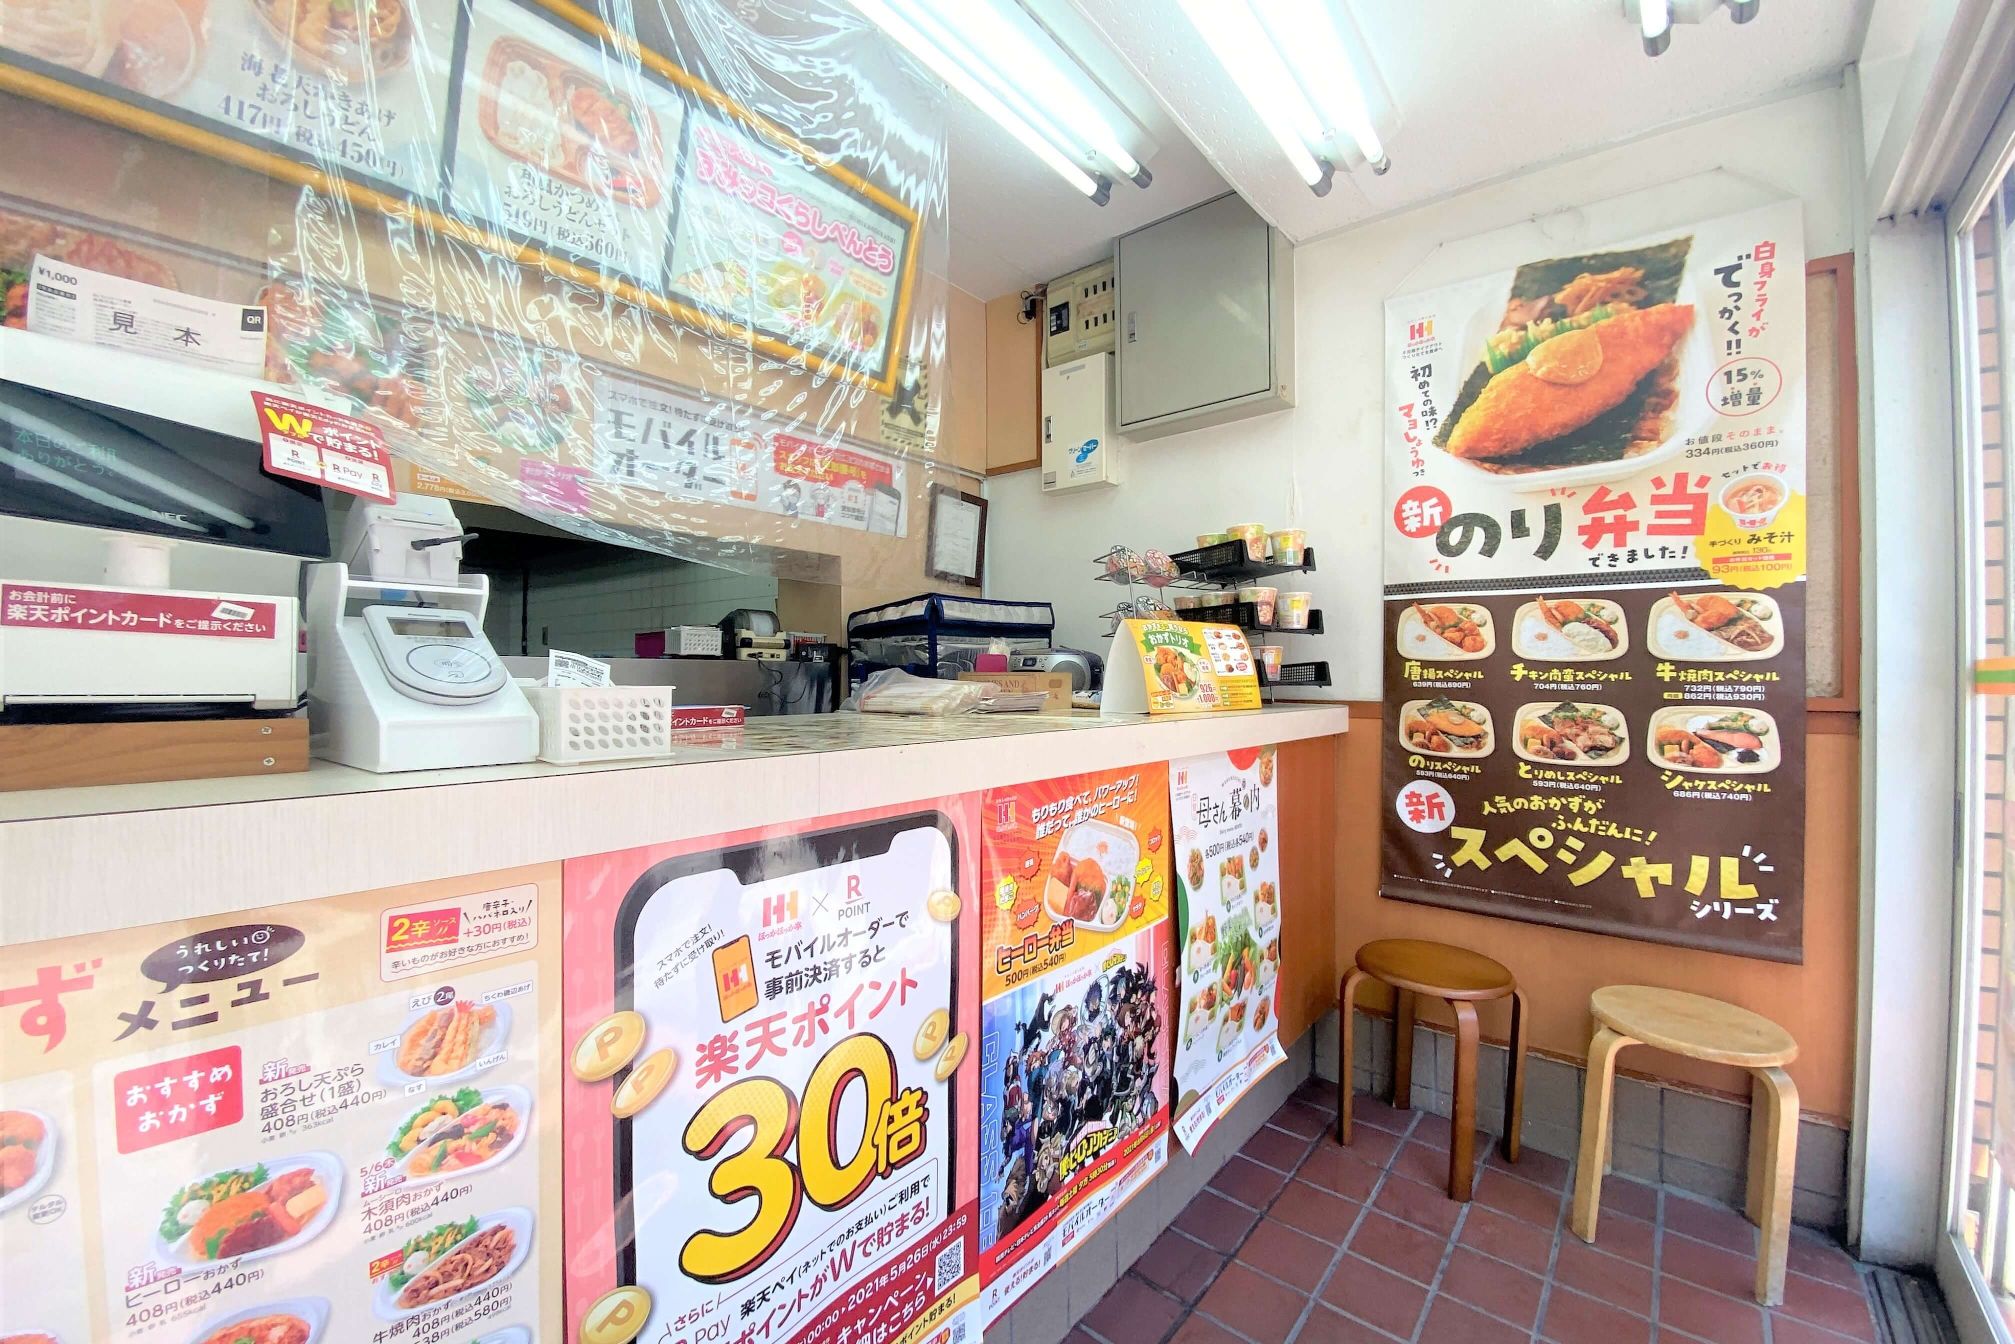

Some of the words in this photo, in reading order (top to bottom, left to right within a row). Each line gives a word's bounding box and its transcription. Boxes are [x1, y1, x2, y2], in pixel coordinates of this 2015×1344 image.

[504, 185, 631, 240] おろしうどんセト
[38, 265, 78, 286] ¥1,000
[1747, 240, 1777, 339] 白身フライが
[247, 315, 261, 325] QR
[1713, 252, 1752, 356] でっかく!!
[109, 312, 138, 335] 見
[173, 327, 201, 347] 本
[1723, 367, 1765, 386] 15%
[1410, 363, 1438, 431] 初めての味!?
[1720, 386, 1763, 407] 増量
[608, 408, 726, 461] モバイル
[1685, 440, 1779, 459] 334円(税込360円)
[343, 465, 363, 480] Pay
[1721, 461, 1788, 479] セットでお得
[153, 510, 187, 522] NEC
[1400, 496, 1442, 534] 新
[1435, 472, 1712, 562] のり弁当
[1709, 537, 1742, 548] 手づくり
[1746, 530, 1795, 544] みそ汁
[1588, 545, 1690, 569] できました!
[8, 589, 77, 605] お会計前に
[7, 604, 266, 633] 楽天ポイントカードをご提示ください
[1148, 630, 1190, 648] おかずトリオ
[1404, 661, 1485, 681] 唐揚スペシャル
[1511, 662, 1632, 683] チキン南蛮スペシャル
[1656, 662, 1781, 683] 牛焼肉スペシャル
[1533, 682, 1603, 692] 704円(税込760円)
[1684, 684, 1765, 694] 732円(税込790円)
[1684, 692, 1765, 702] 862円(税込930円)
[1408, 754, 1482, 775] のりスペシャル
[1518, 762, 1623, 786] とりめしスペシャル
[1660, 770, 1772, 793] シャケスペシャル
[1532, 780, 1602, 793] 593円(税込640円)
[1673, 790, 1753, 802] 686円(税込740円)
[1404, 790, 1447, 825] 新
[1481, 794, 1606, 818] 人気のおかずが
[1551, 815, 1658, 848] ふんだんに!
[1449, 825, 1759, 901] スペシャル
[463, 917, 532, 938] +30円(税込)
[838, 901, 871, 921] POINT
[1689, 898, 1780, 922] シリーズ
[176, 934, 249, 958] うれしい
[391, 917, 431, 942] 2辛
[433, 918, 457, 928] ソース
[656, 923, 713, 970] スマホで注文!
[764, 910, 910, 970] モバイルオーダーで
[996, 919, 1075, 975] ヒーロー弁当
[178, 947, 269, 975] つくりたて!
[391, 932, 530, 970] 辛いものがお好きな方におすすめ!
[654, 929, 725, 990] 待たずに受け取り!
[764, 943, 886, 1001] 事前決済すると
[1005, 953, 1067, 987] 500円(税込540円)
[113, 972, 320, 1043] メニュー
[411, 995, 432, 1009] えび
[484, 983, 532, 1003] ちくわ磯辺あげ
[373, 1038, 398, 1052] カレイ
[695, 967, 919, 1090] 楽天ポイント
[478, 1053, 506, 1068] いんげん
[126, 1063, 232, 1107] おすすめ
[260, 1062, 365, 1103] おろし天ぷら
[260, 1078, 362, 1121] 盛合せ(1盛)
[407, 1083, 424, 1094] なす
[137, 1091, 224, 1134] おかず
[261, 1088, 387, 1135] 408円(税込440円)
[980, 1030, 1001, 1186] CLASS
[679, 1032, 930, 1285] 30倍
[31, 1199, 63, 1213] タルタル
[360, 1182, 443, 1223] 木須肉おかず
[363, 1184, 473, 1235] 408円(税込440円)
[739, 1174, 931, 1321] 楽天ペイ(ネットでのお支払い)ご利用で
[125, 1257, 243, 1309] ヒーローおかず
[125, 1268, 265, 1327] 408円(税込440円)
[373, 1299, 452, 1344] 牛焼肉おかず
[412, 1281, 513, 1340] 408円(税込440円)
[673, 1300, 713, 1331] さらに
[836, 1271, 928, 1344] キャンペーン
